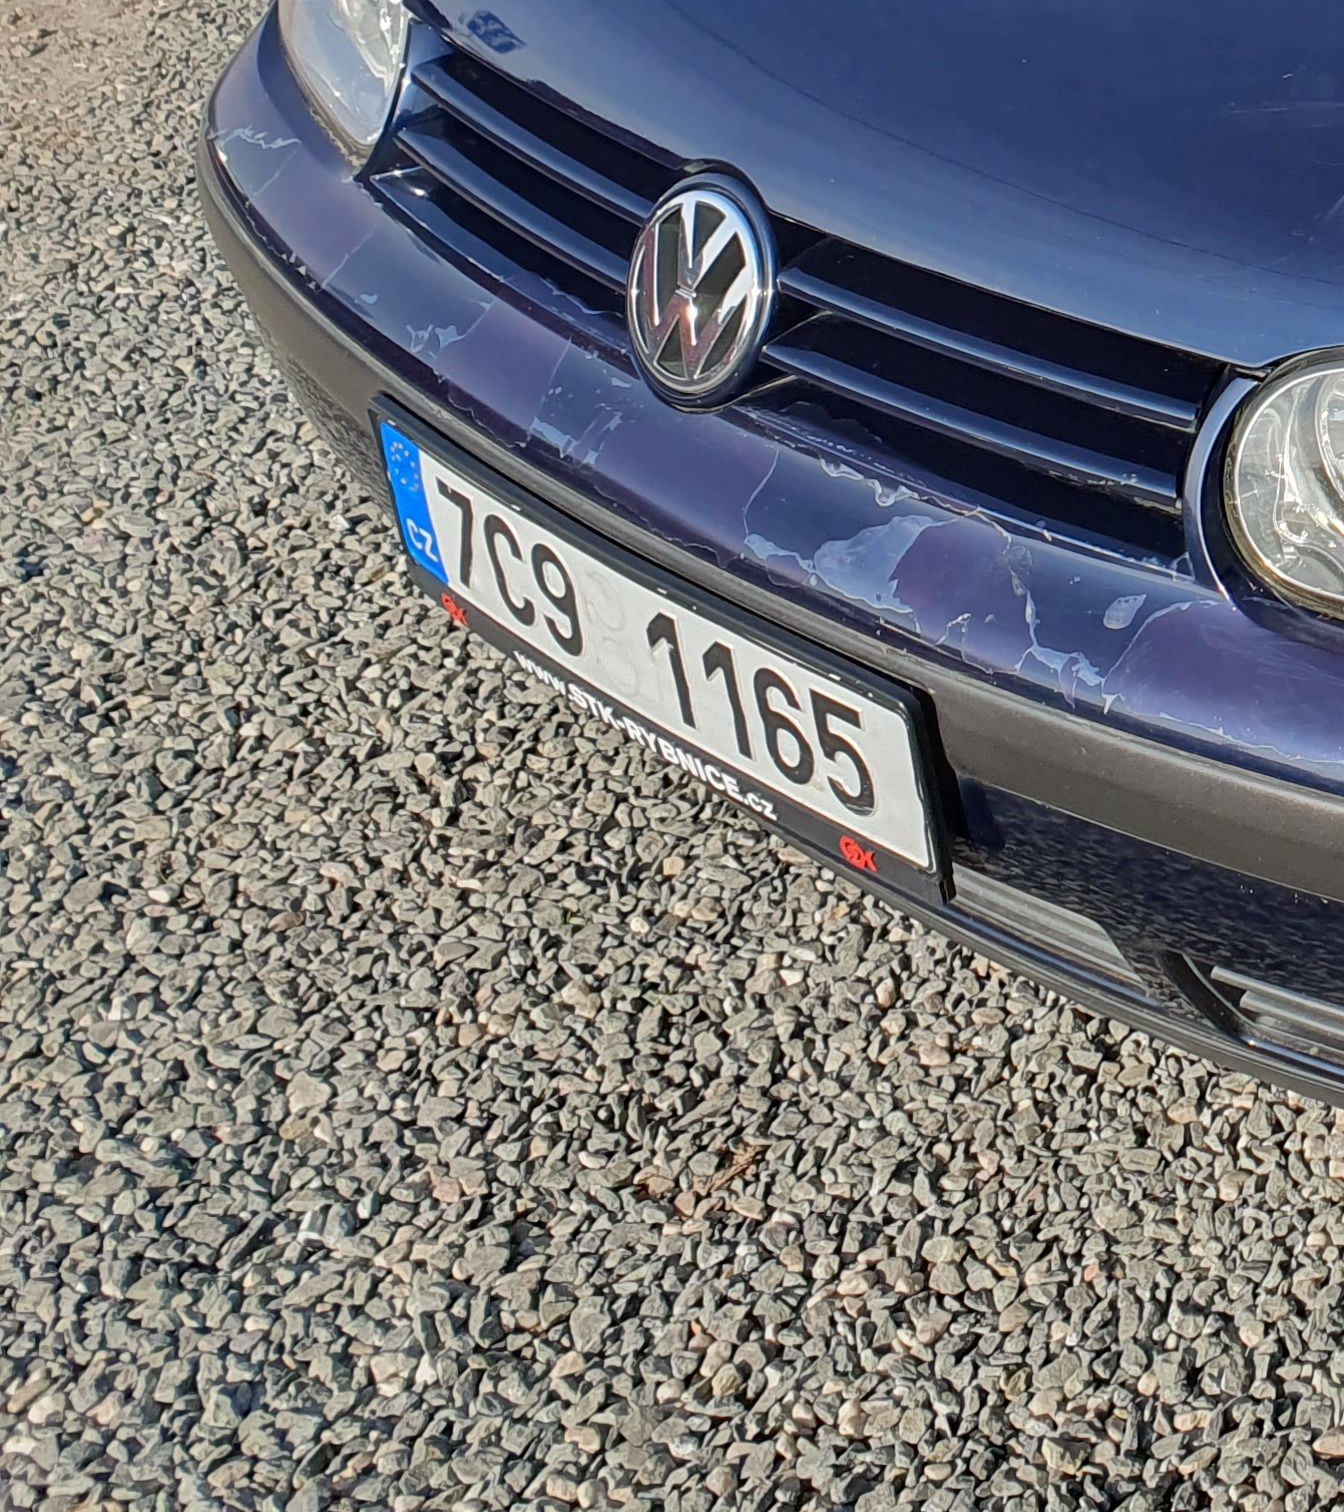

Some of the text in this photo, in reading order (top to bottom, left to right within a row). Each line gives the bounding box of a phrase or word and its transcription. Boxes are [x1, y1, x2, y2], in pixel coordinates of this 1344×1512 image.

[405, 518, 439, 563] CZ
[436, 475, 877, 818] 7C9 1165
[513, 650, 778, 821] www.STK-RYBNICE.cz
